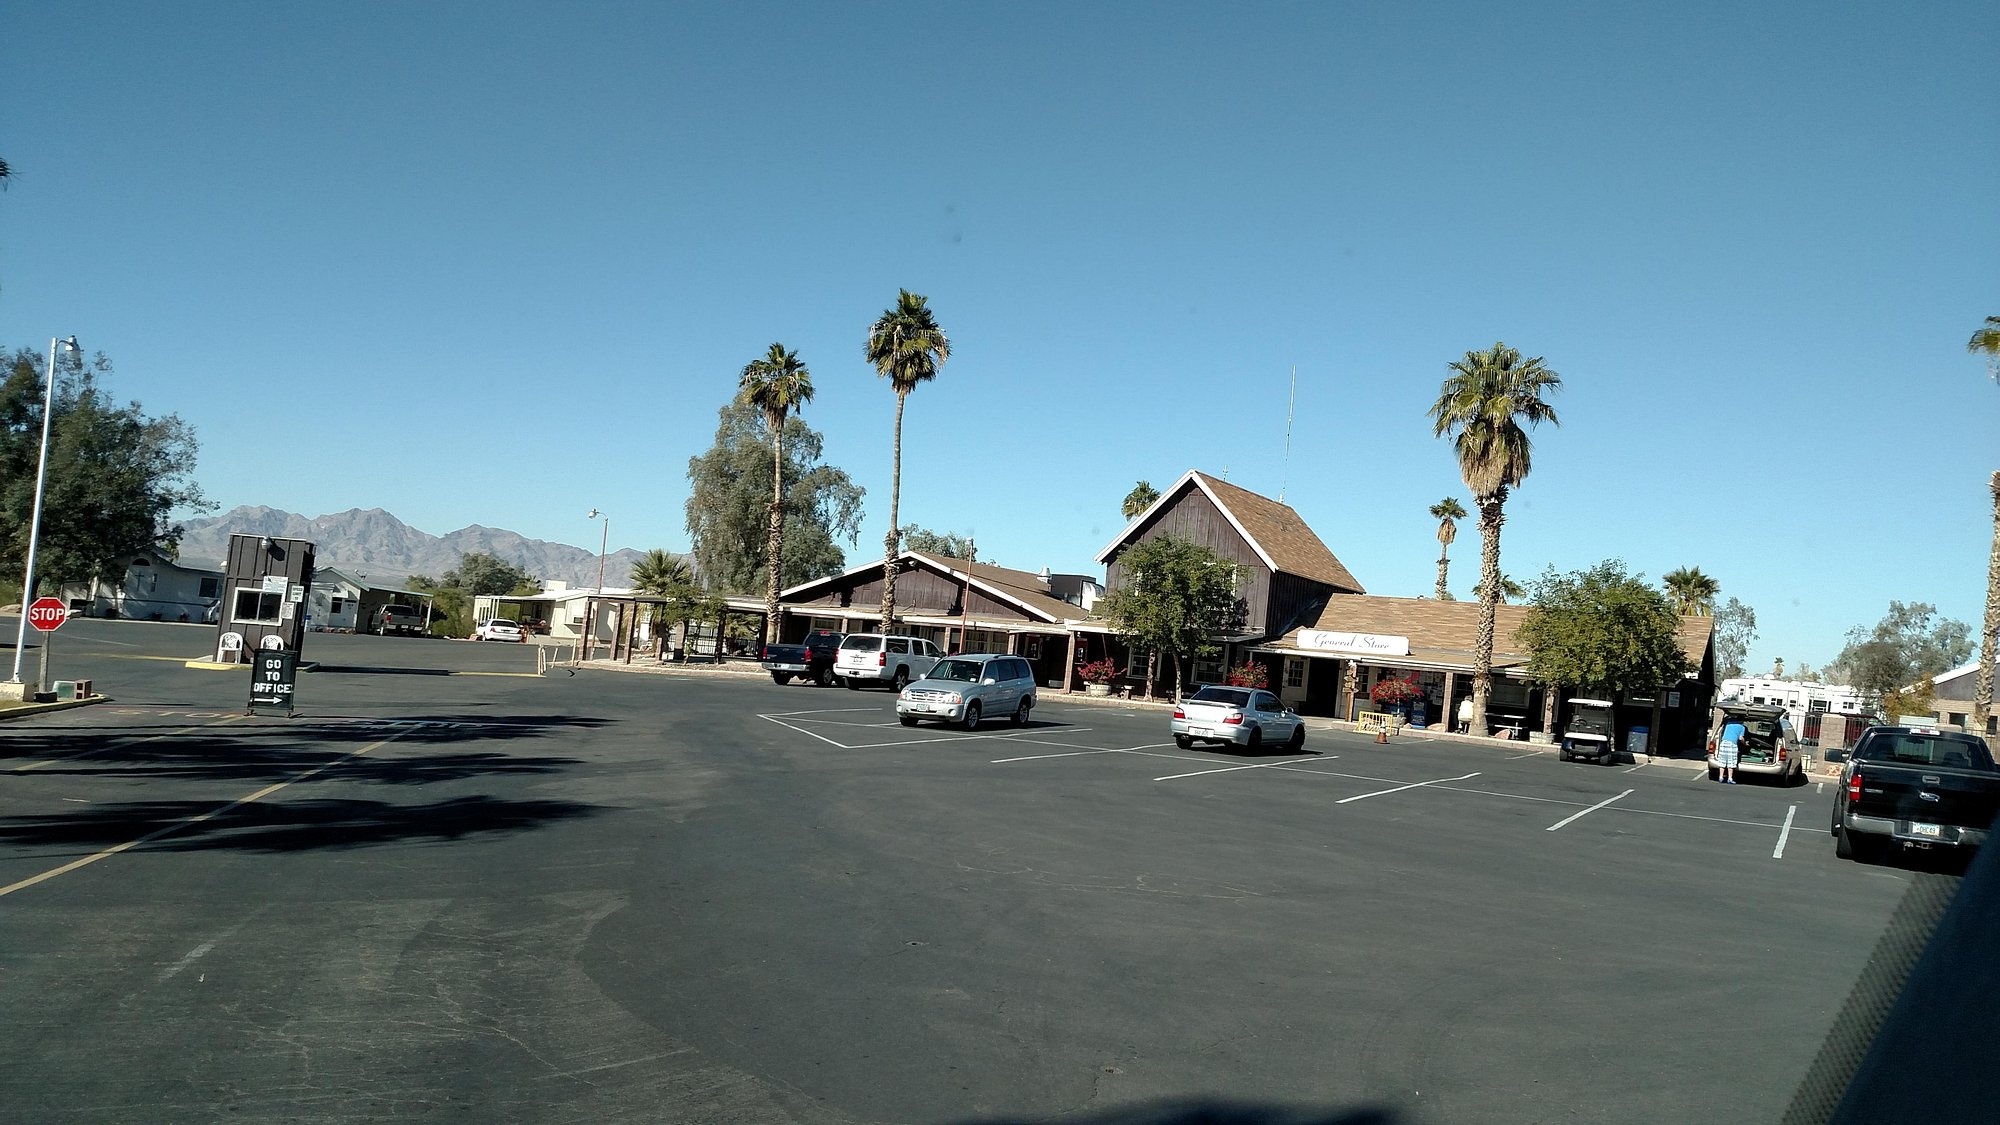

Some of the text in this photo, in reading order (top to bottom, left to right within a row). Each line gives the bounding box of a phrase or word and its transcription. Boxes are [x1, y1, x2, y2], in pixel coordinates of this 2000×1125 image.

[30, 607, 65, 621] STOP
[1314, 633, 1390, 649] General Store
[266, 659, 282, 669] GO
[265, 671, 281, 681] TO
[253, 682, 292, 694] OFFICE
